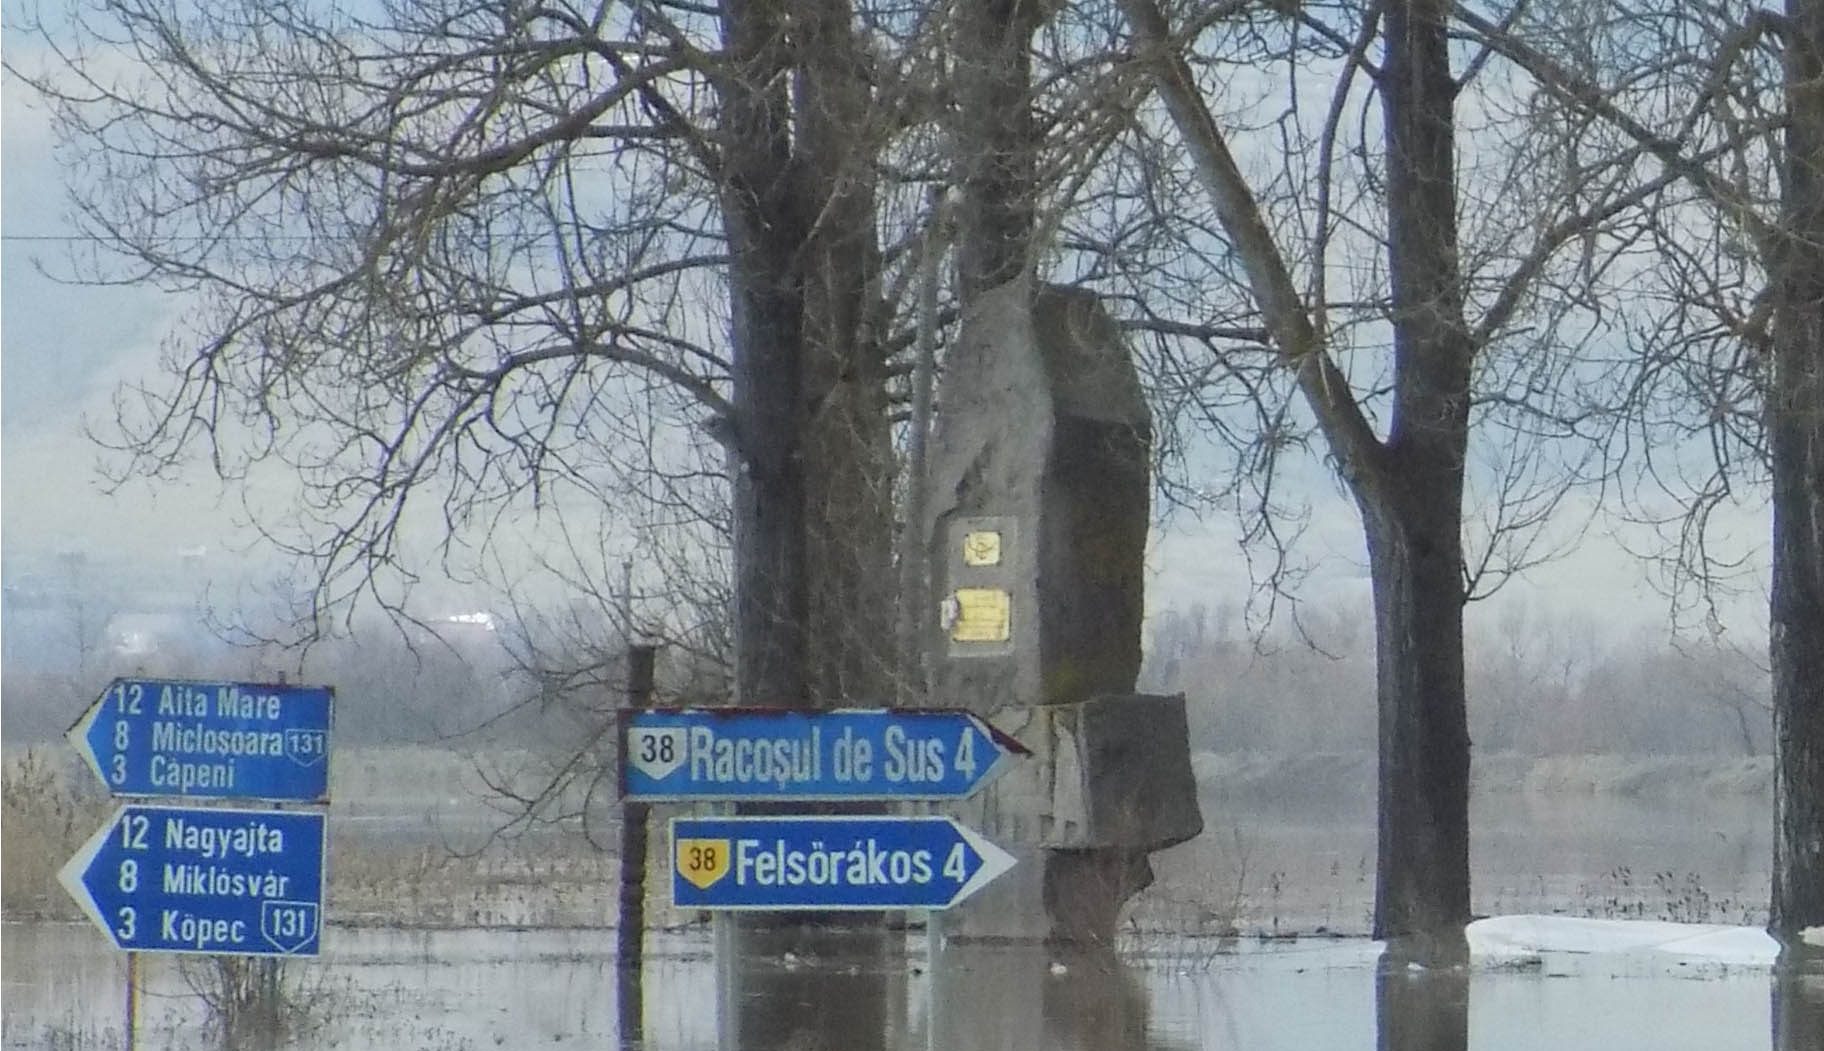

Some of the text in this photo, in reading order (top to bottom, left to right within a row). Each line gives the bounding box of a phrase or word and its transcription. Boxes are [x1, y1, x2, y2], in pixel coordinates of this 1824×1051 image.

[113, 684, 281, 720] 12 Aita Mare
[115, 721, 129, 751] 8
[288, 734, 325, 754] 131
[641, 734, 675, 763] 38
[111, 756, 127, 785] 3
[833, 726, 872, 782] de
[884, 725, 945, 783] Sus
[954, 727, 977, 781] 4
[121, 815, 284, 858] 12 Nagyajta
[689, 847, 717, 871] 38
[943, 842, 966, 883] 4
[119, 859, 290, 897] 8 Miklósvár
[118, 907, 246, 948] 3 Köpec
[272, 908, 306, 937] 131
